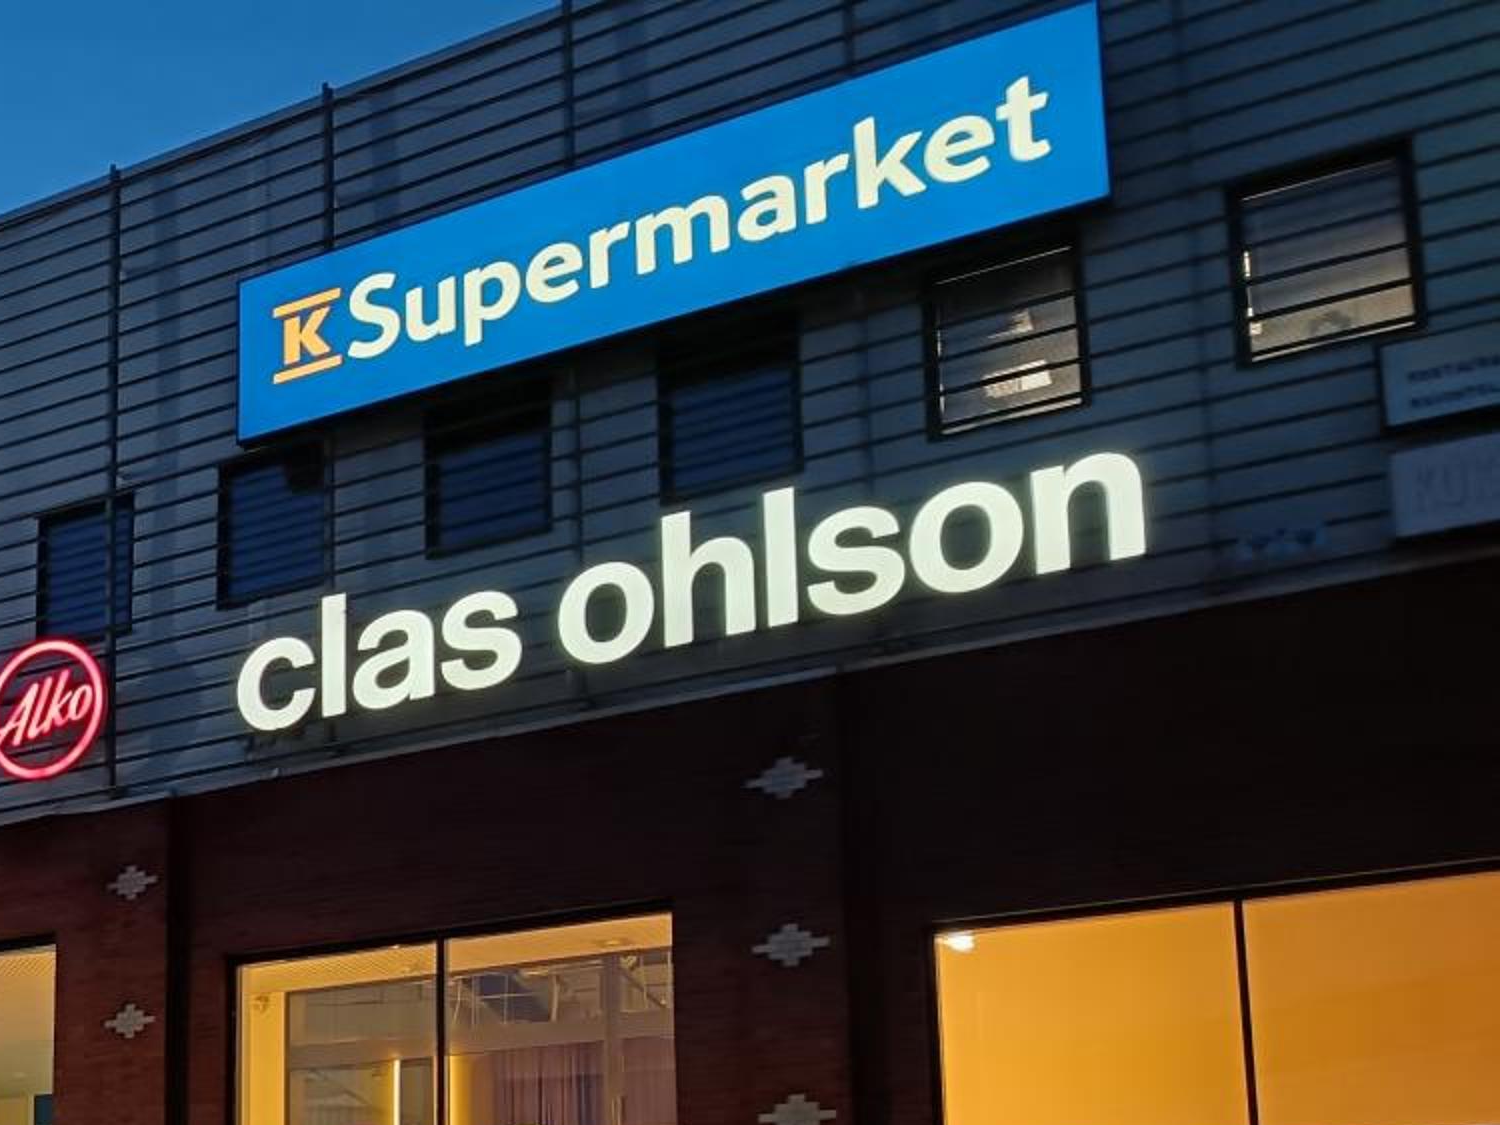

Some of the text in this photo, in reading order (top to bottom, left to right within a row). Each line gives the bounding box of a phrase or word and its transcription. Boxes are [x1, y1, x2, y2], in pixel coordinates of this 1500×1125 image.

[277, 74, 1052, 374] K Supermarket
[236, 450, 1148, 731] clas ohlson
